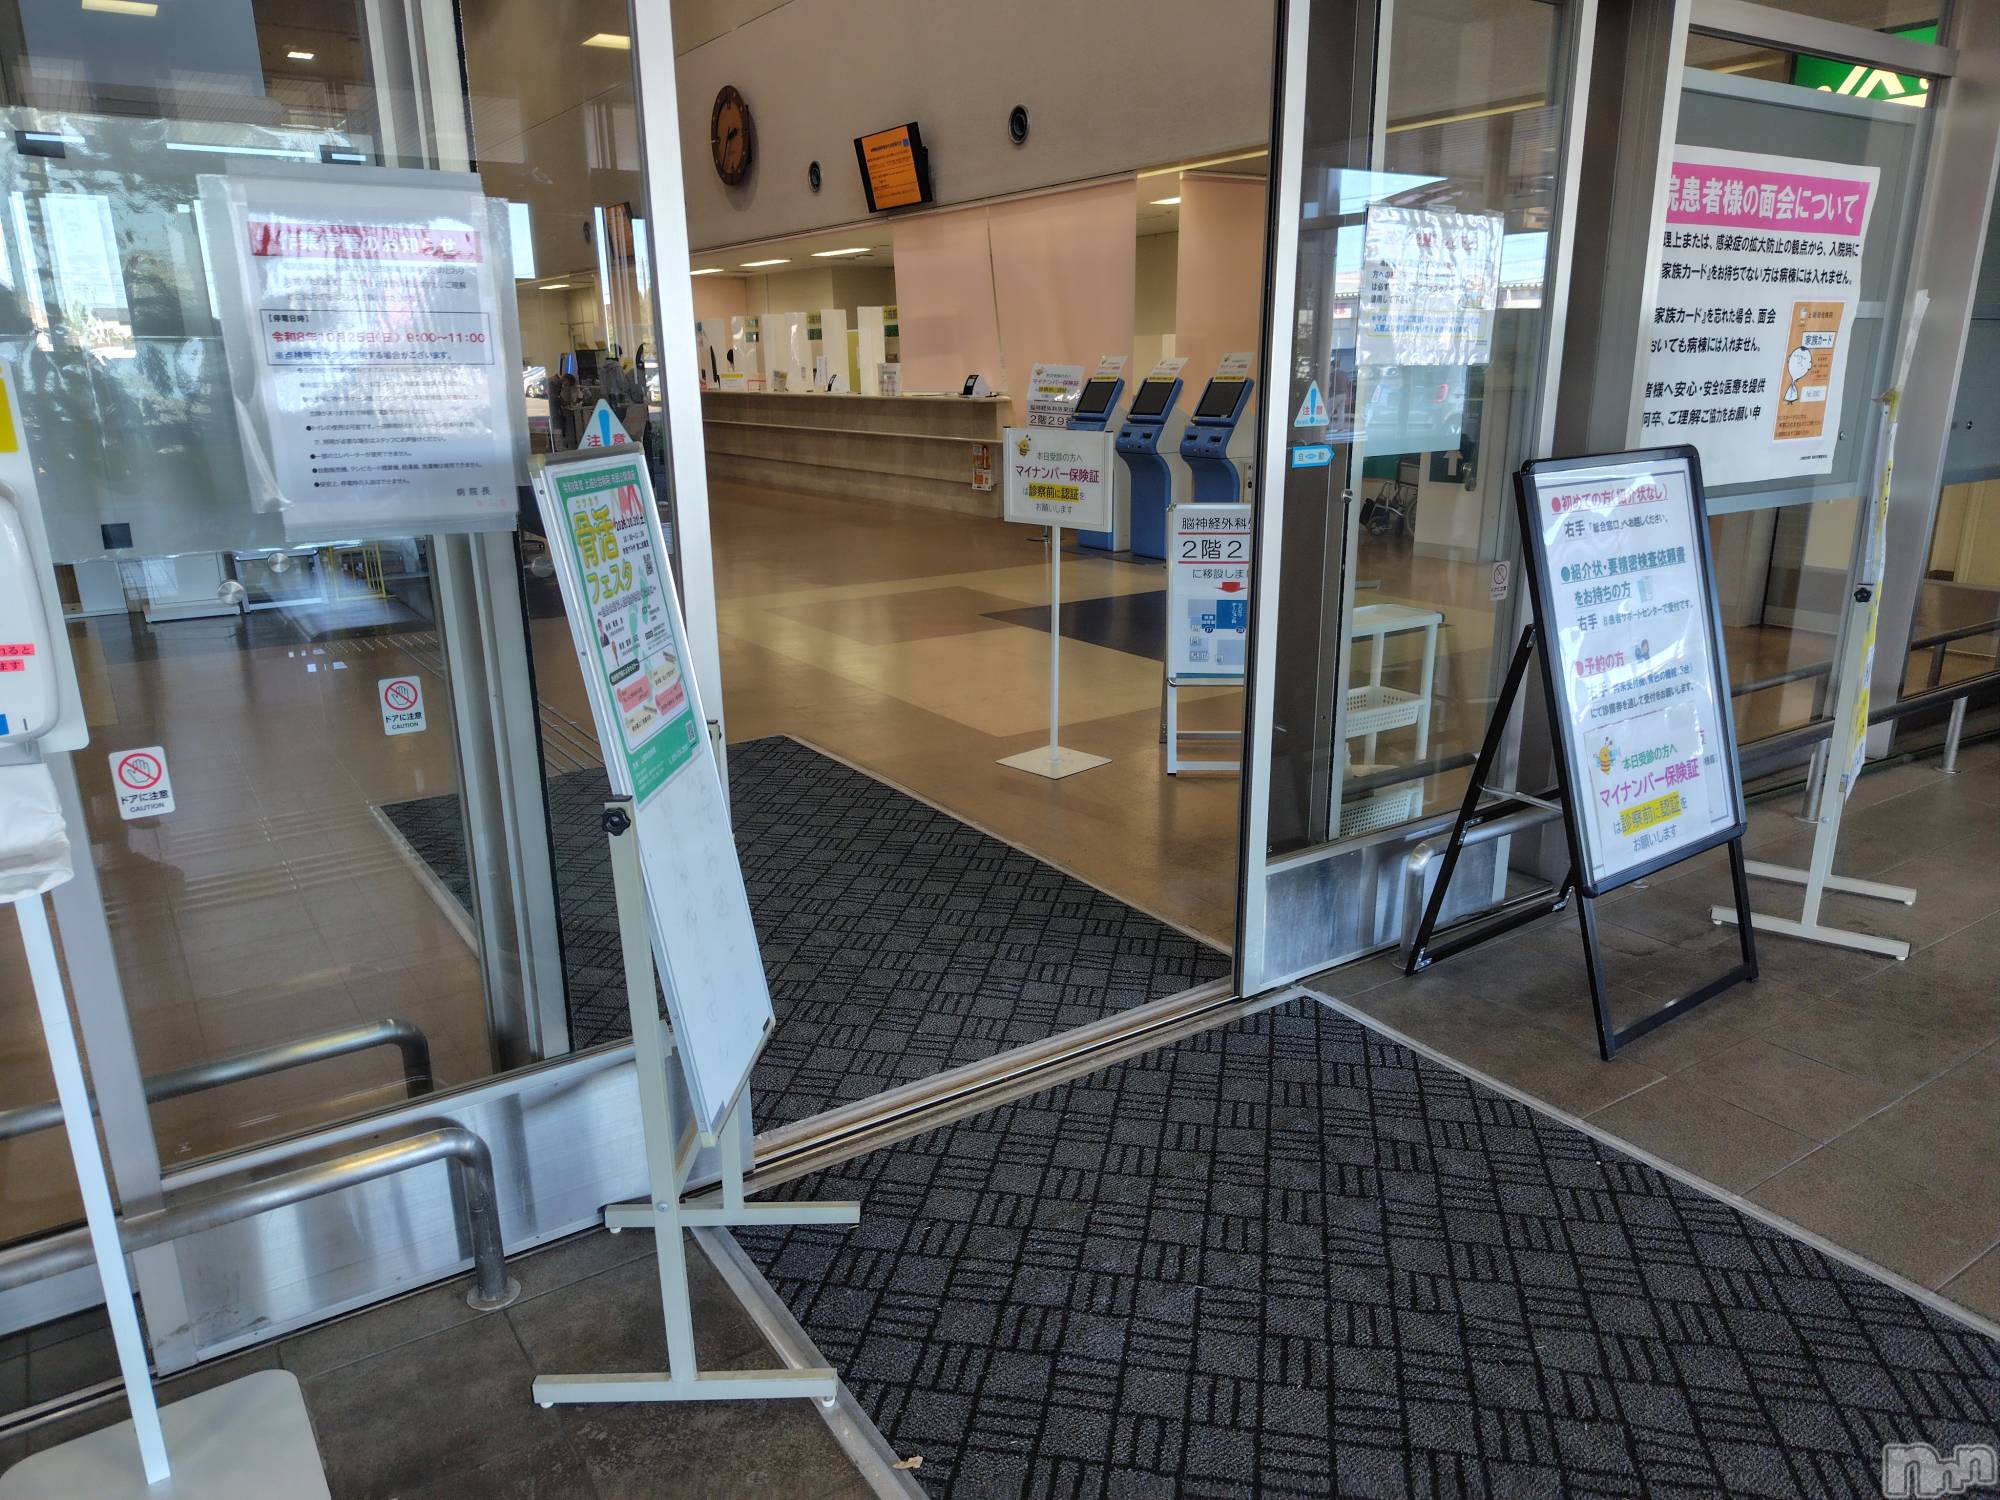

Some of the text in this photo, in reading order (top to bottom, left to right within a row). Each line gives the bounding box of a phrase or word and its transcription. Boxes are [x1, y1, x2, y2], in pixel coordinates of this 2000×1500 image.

[1804, 334, 1834, 346] 家族カード
[1037, 451, 1084, 463] 本日受診の方へ
[1015, 465, 1100, 483] マイナンバー保険証
[1022, 483, 1086, 501] は診察前に認証を
[1035, 503, 1073, 514] お願いします
[1182, 517, 1251, 531] 脳神経外科
[1564, 519, 1585, 538] 右手
[573, 505, 620, 569] 骨活
[586, 558, 633, 605] フェスタ
[1192, 568, 1249, 579] に移設しま
[1574, 581, 1632, 606] をお持ちの方
[1577, 613, 1598, 632] 右手
[1584, 650, 1625, 675] 予約の方
[385, 711, 422, 723] ドアに注意
[391, 722, 419, 730] CAUTION
[1622, 743, 1678, 770] 本日受診の方へ
[1599, 758, 1700, 808] マイナンバー保険証
[120, 789, 170, 806] ドアに注意
[129, 802, 165, 813] CAUTION
[1613, 795, 1688, 835] は診察前に認証を
[1633, 824, 1678, 852] お願いします
